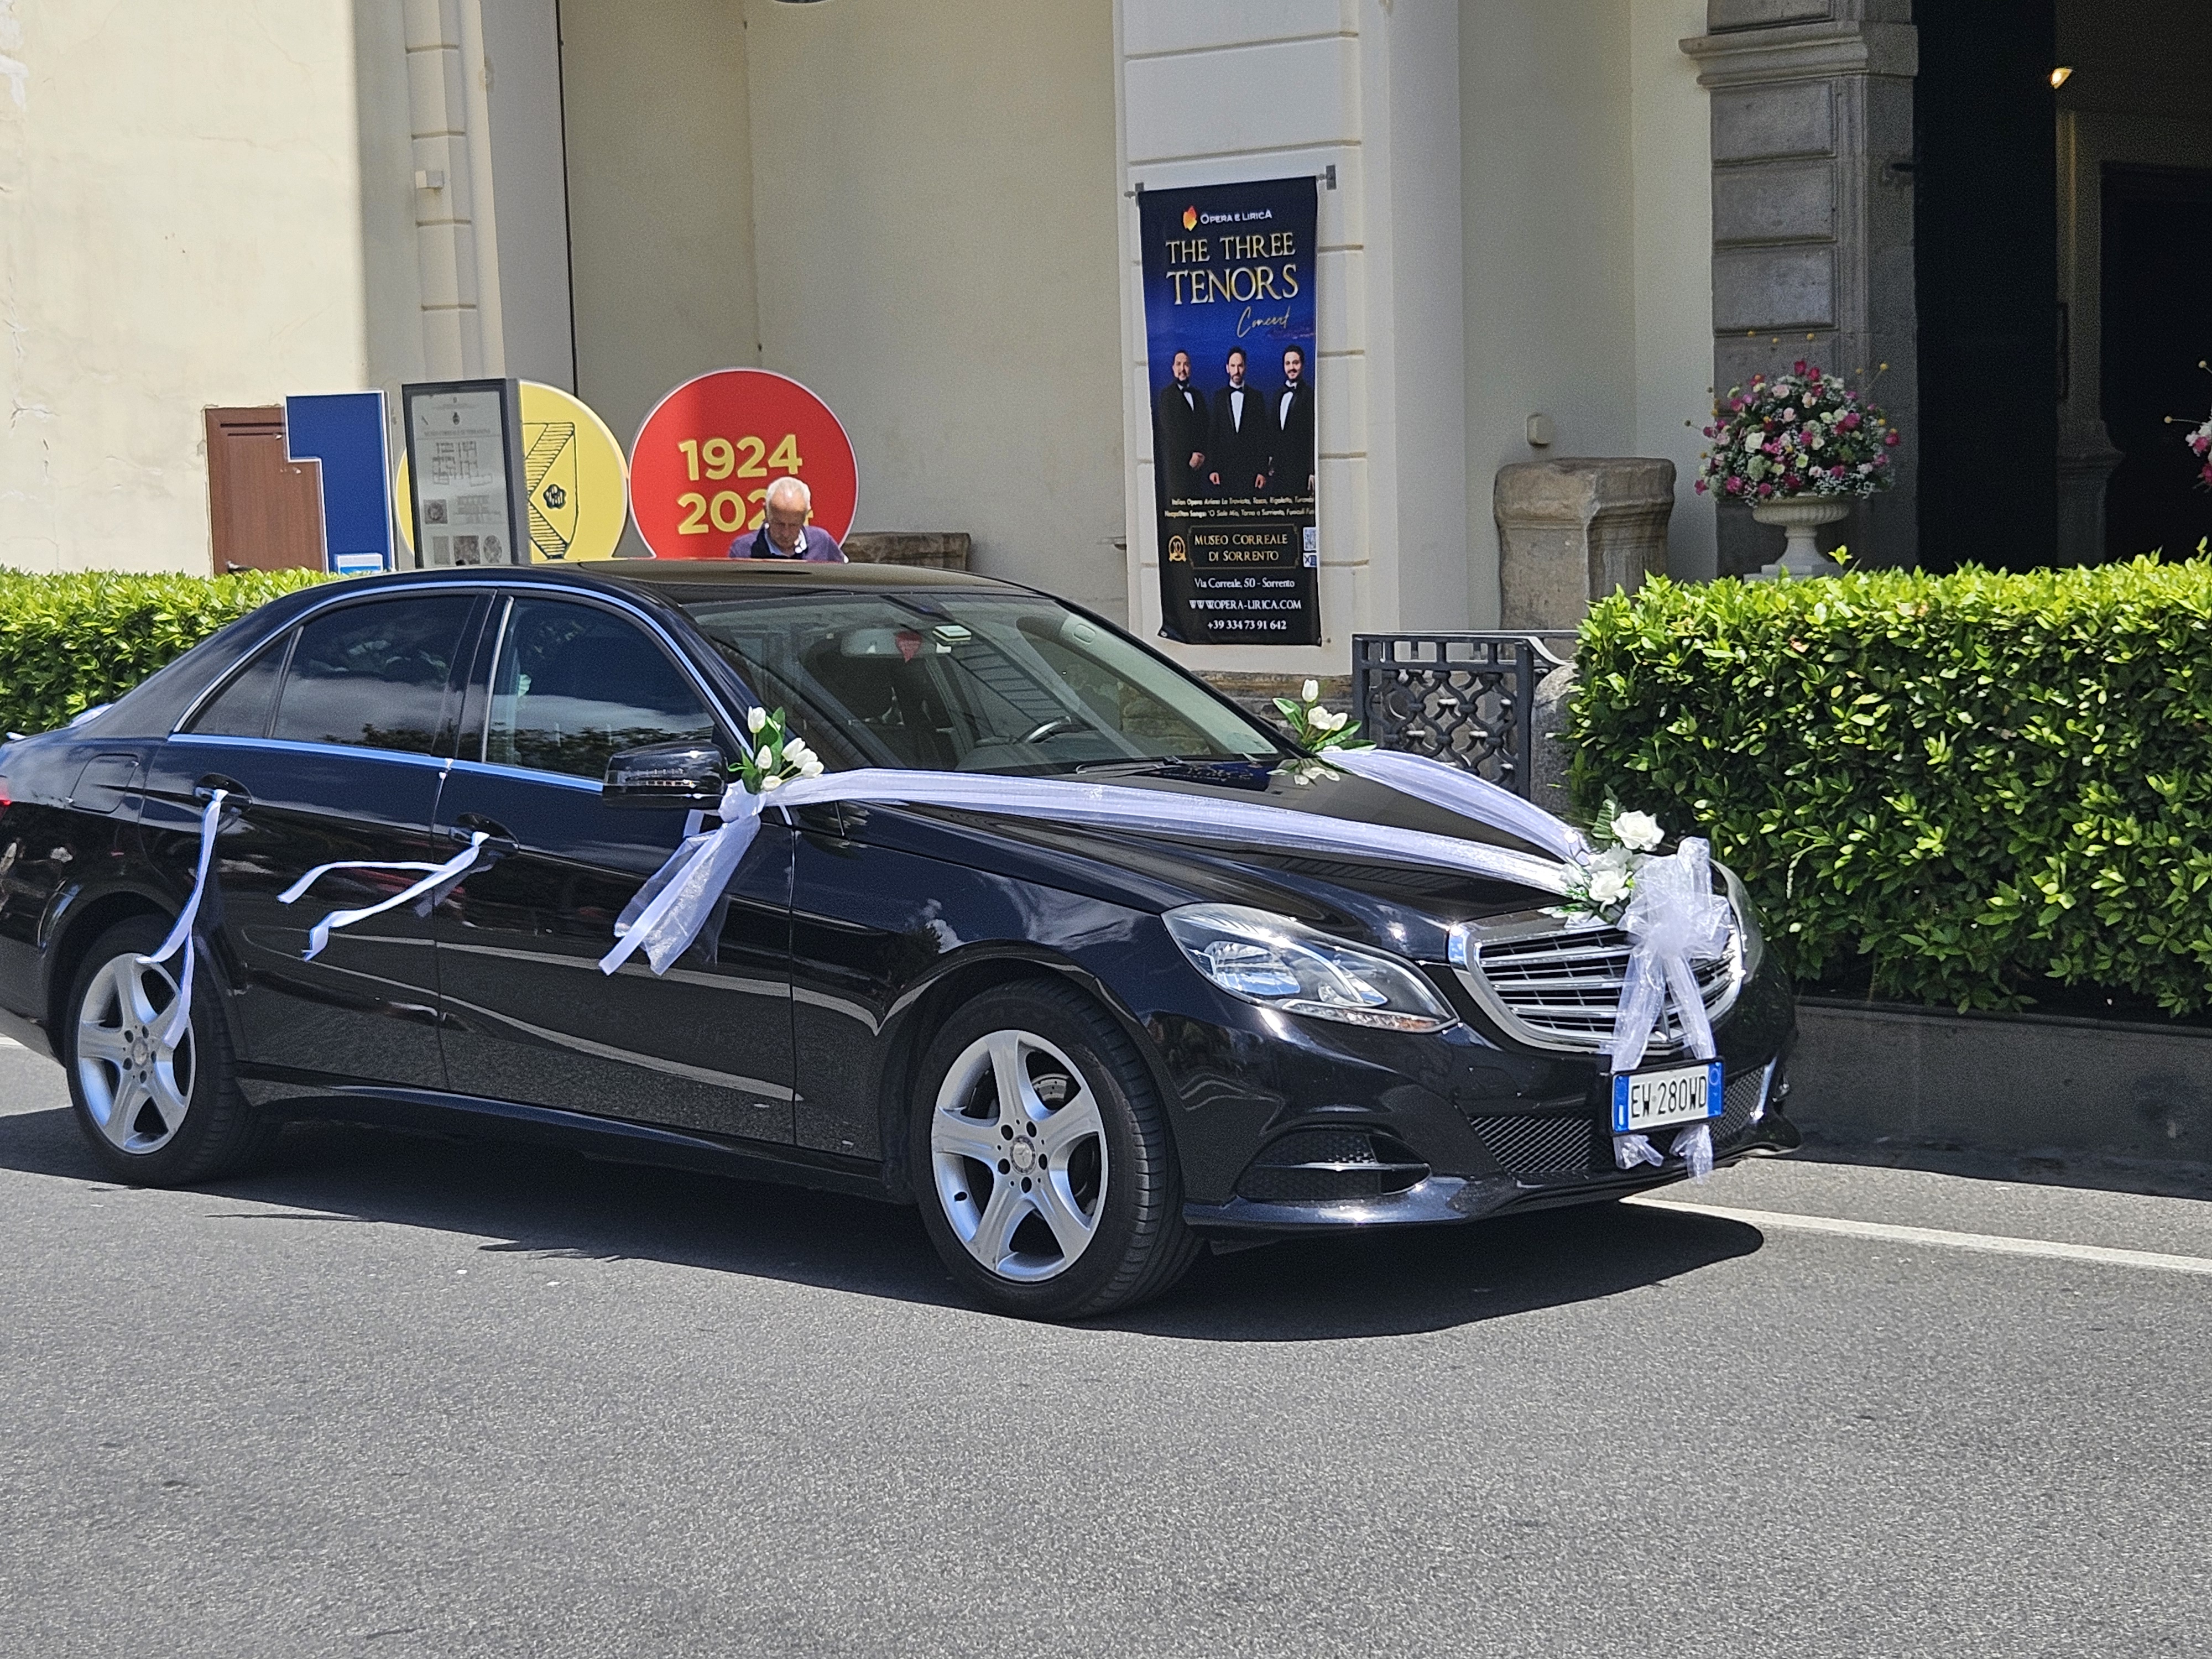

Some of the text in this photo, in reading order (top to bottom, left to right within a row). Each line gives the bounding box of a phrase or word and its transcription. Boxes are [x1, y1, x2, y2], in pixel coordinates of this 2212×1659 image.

[1200, 208, 1272, 225] OPERA E LIRICA
[1165, 232, 1296, 264] THE THREE
[1166, 264, 1298, 305] TENORS
[1237, 306, 1291, 338] Concert
[677, 434, 803, 481] 1924
[1194, 534, 1288, 546] MUSEO CORREALE
[1208, 550, 1279, 562] DI SORRENTO
[1194, 577, 1207, 588] Via
[1244, 578, 1256, 588] 50
[1262, 577, 1295, 588] Sorrento
[1207, 619, 1287, 629] +39 334 73 91 642
